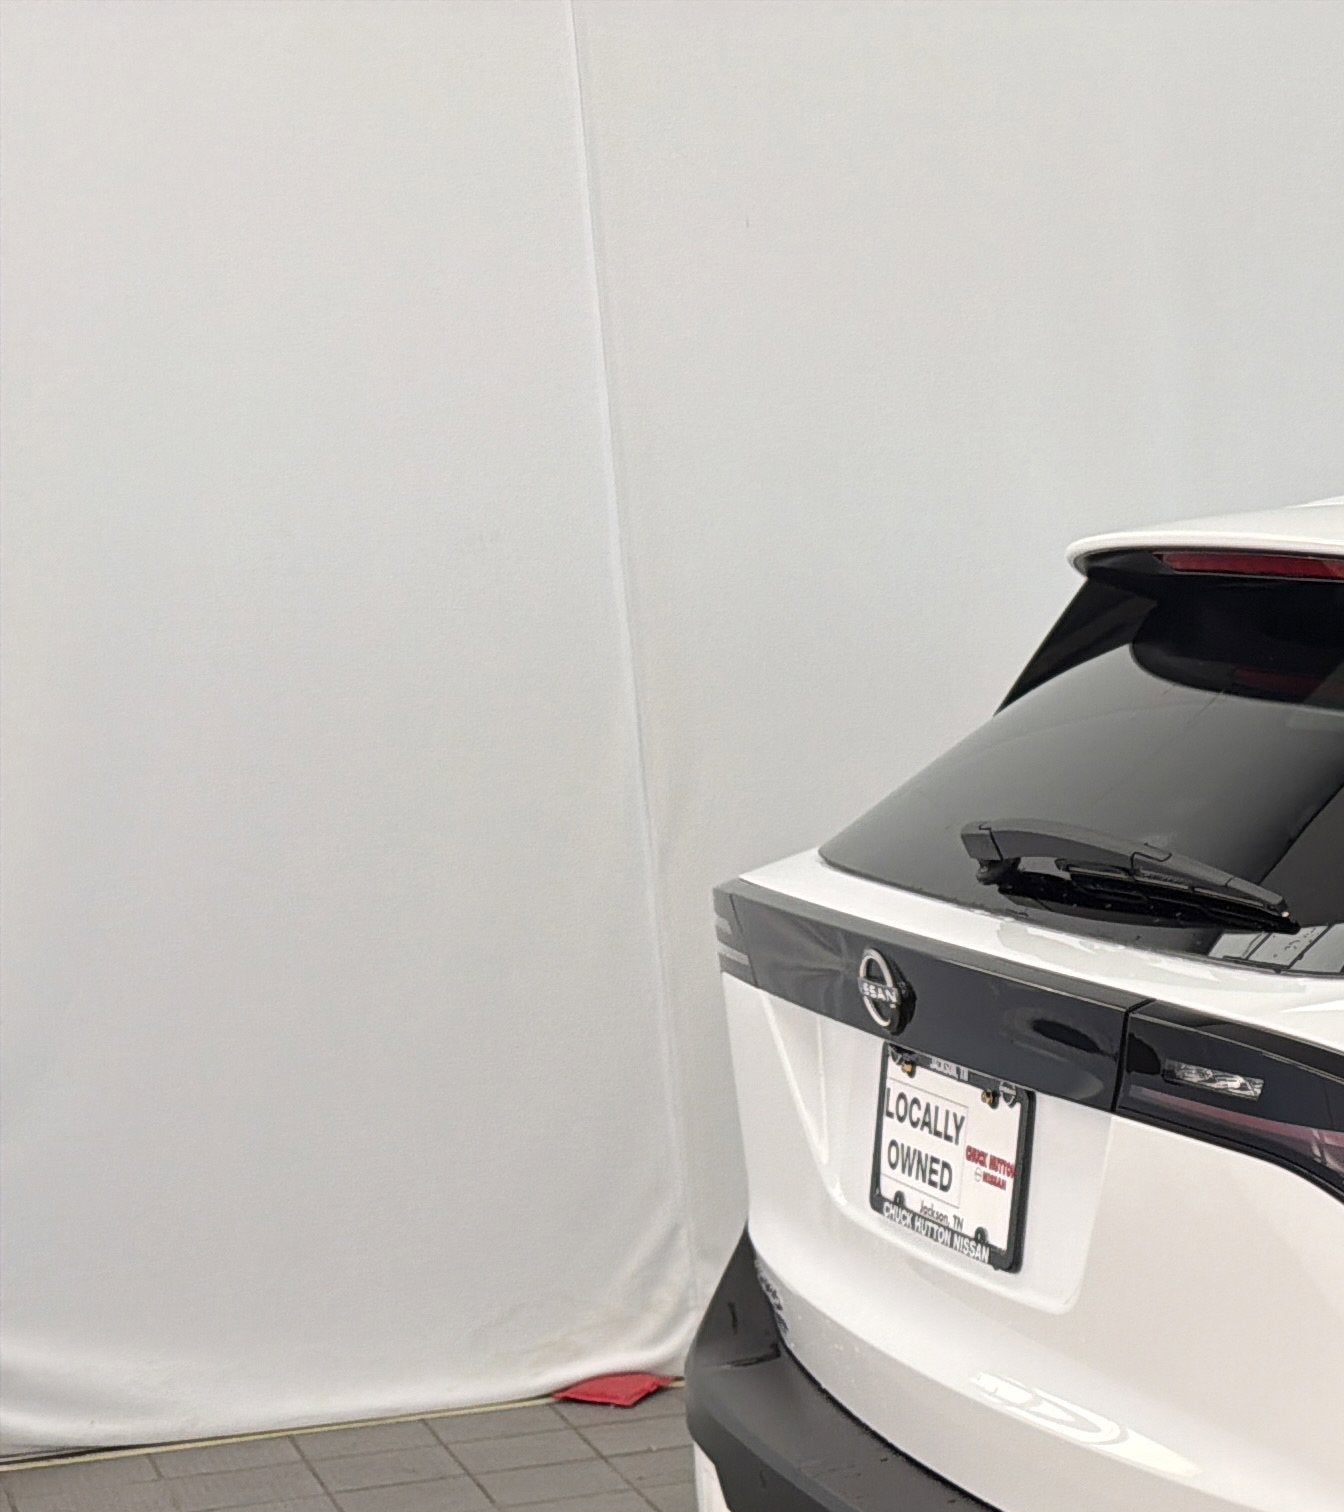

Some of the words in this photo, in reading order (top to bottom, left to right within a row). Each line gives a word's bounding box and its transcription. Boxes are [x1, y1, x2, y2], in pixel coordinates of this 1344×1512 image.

[884, 1087, 965, 1146] LOCALLY
[888, 1139, 953, 1193] OWNED
[883, 1201, 912, 1231] CHUCK
[914, 1215, 951, 1248] HUTTON
[953, 1233, 989, 1264] NISSAN
